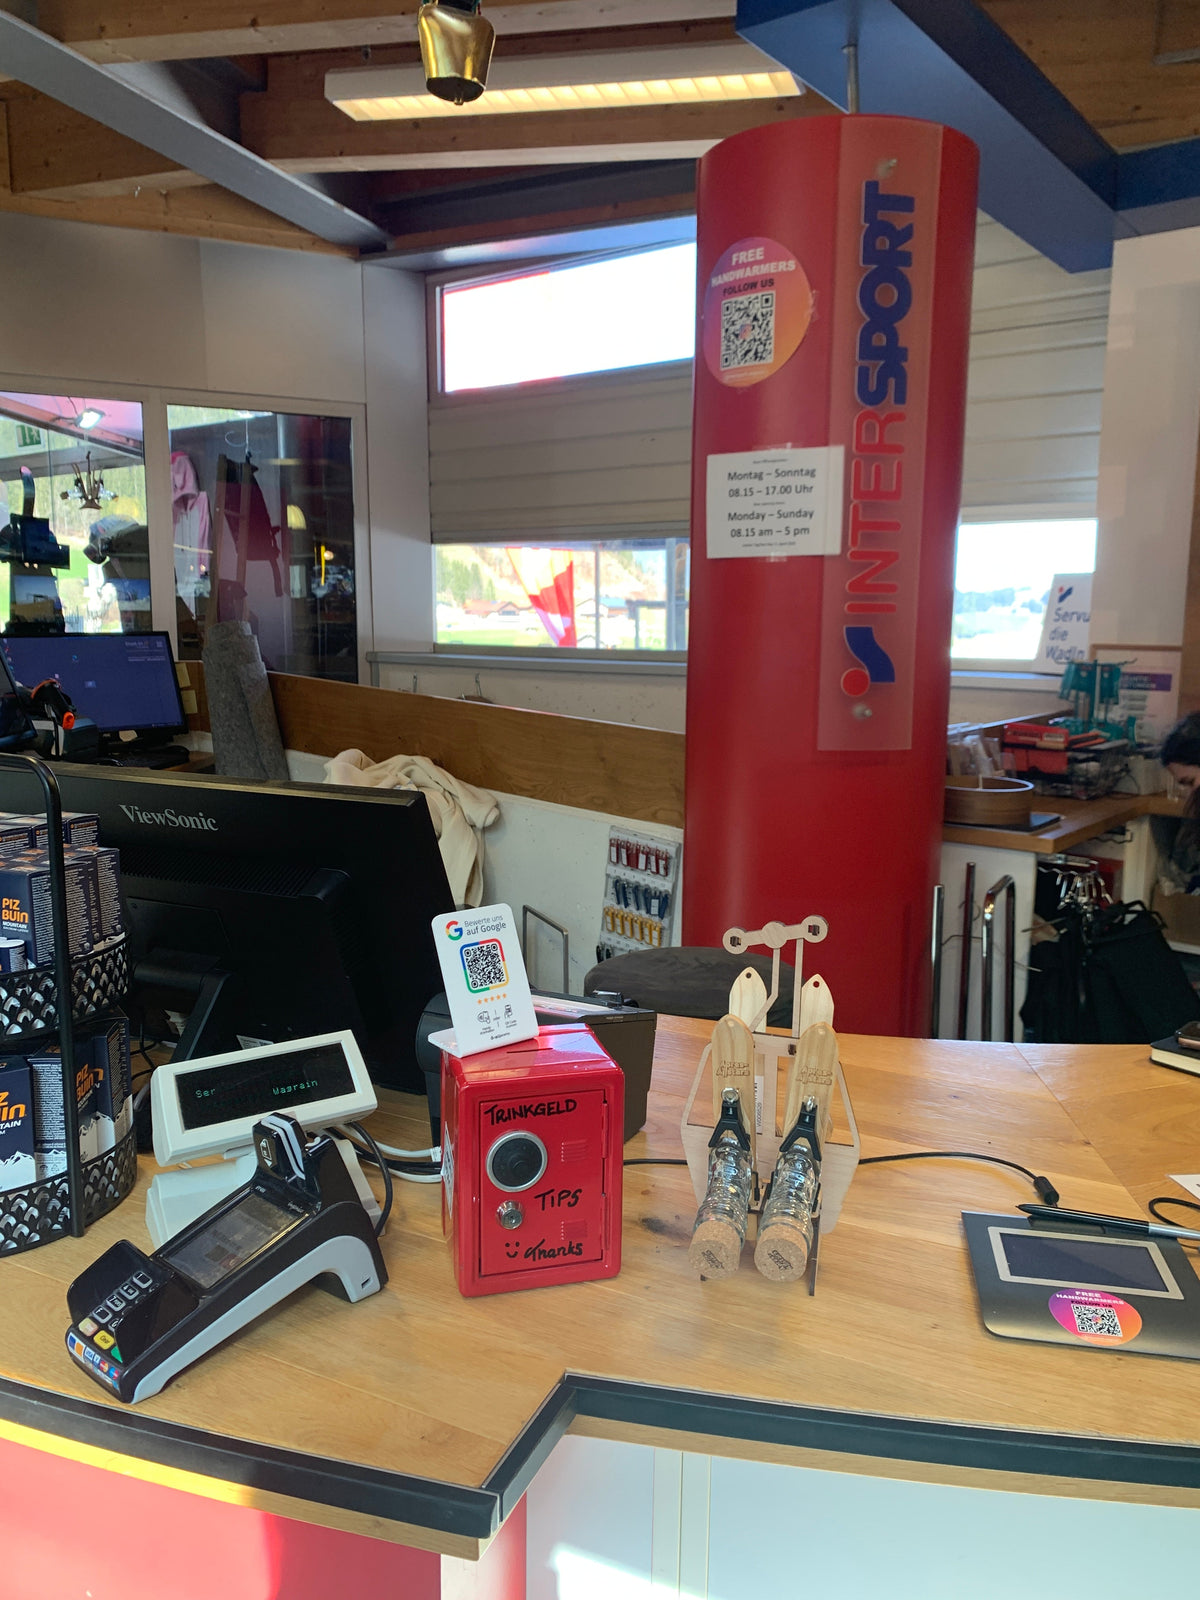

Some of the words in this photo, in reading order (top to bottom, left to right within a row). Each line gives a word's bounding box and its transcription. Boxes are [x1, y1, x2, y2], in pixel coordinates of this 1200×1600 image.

[732, 247, 764, 266] FREE
[711, 260, 796, 287] HANDWARMERS
[723, 281, 758, 296] FOLLOW
[760, 278, 774, 288] US
[844, 179, 917, 615] INTERSPORT
[728, 471, 763, 481] Montag
[775, 468, 816, 478] Sonntag
[728, 487, 754, 497] 08.15
[765, 485, 792, 495] 17.00
[795, 484, 814, 494] Uhr
[728, 511, 766, 522] Monday
[777, 509, 814, 520] Sunday
[730, 528, 755, 538] 08.15
[758, 528, 773, 536] am
[785, 526, 790, 535] 5
[794, 527, 810, 536] pm
[1049, 627, 1068, 642] die
[120, 804, 219, 832] ViewSonic
[2, 898, 20, 910] PIZ
[464, 918, 491, 927] Bewerte
[466, 926, 479, 935] auf
[480, 922, 507, 933] Google
[485, 1100, 577, 1125] TRINKGELD
[534, 1188, 583, 1211] TIPS
[524, 1239, 583, 1261] Thanks
[1056, 1293, 1124, 1305] HANDWARMERS
